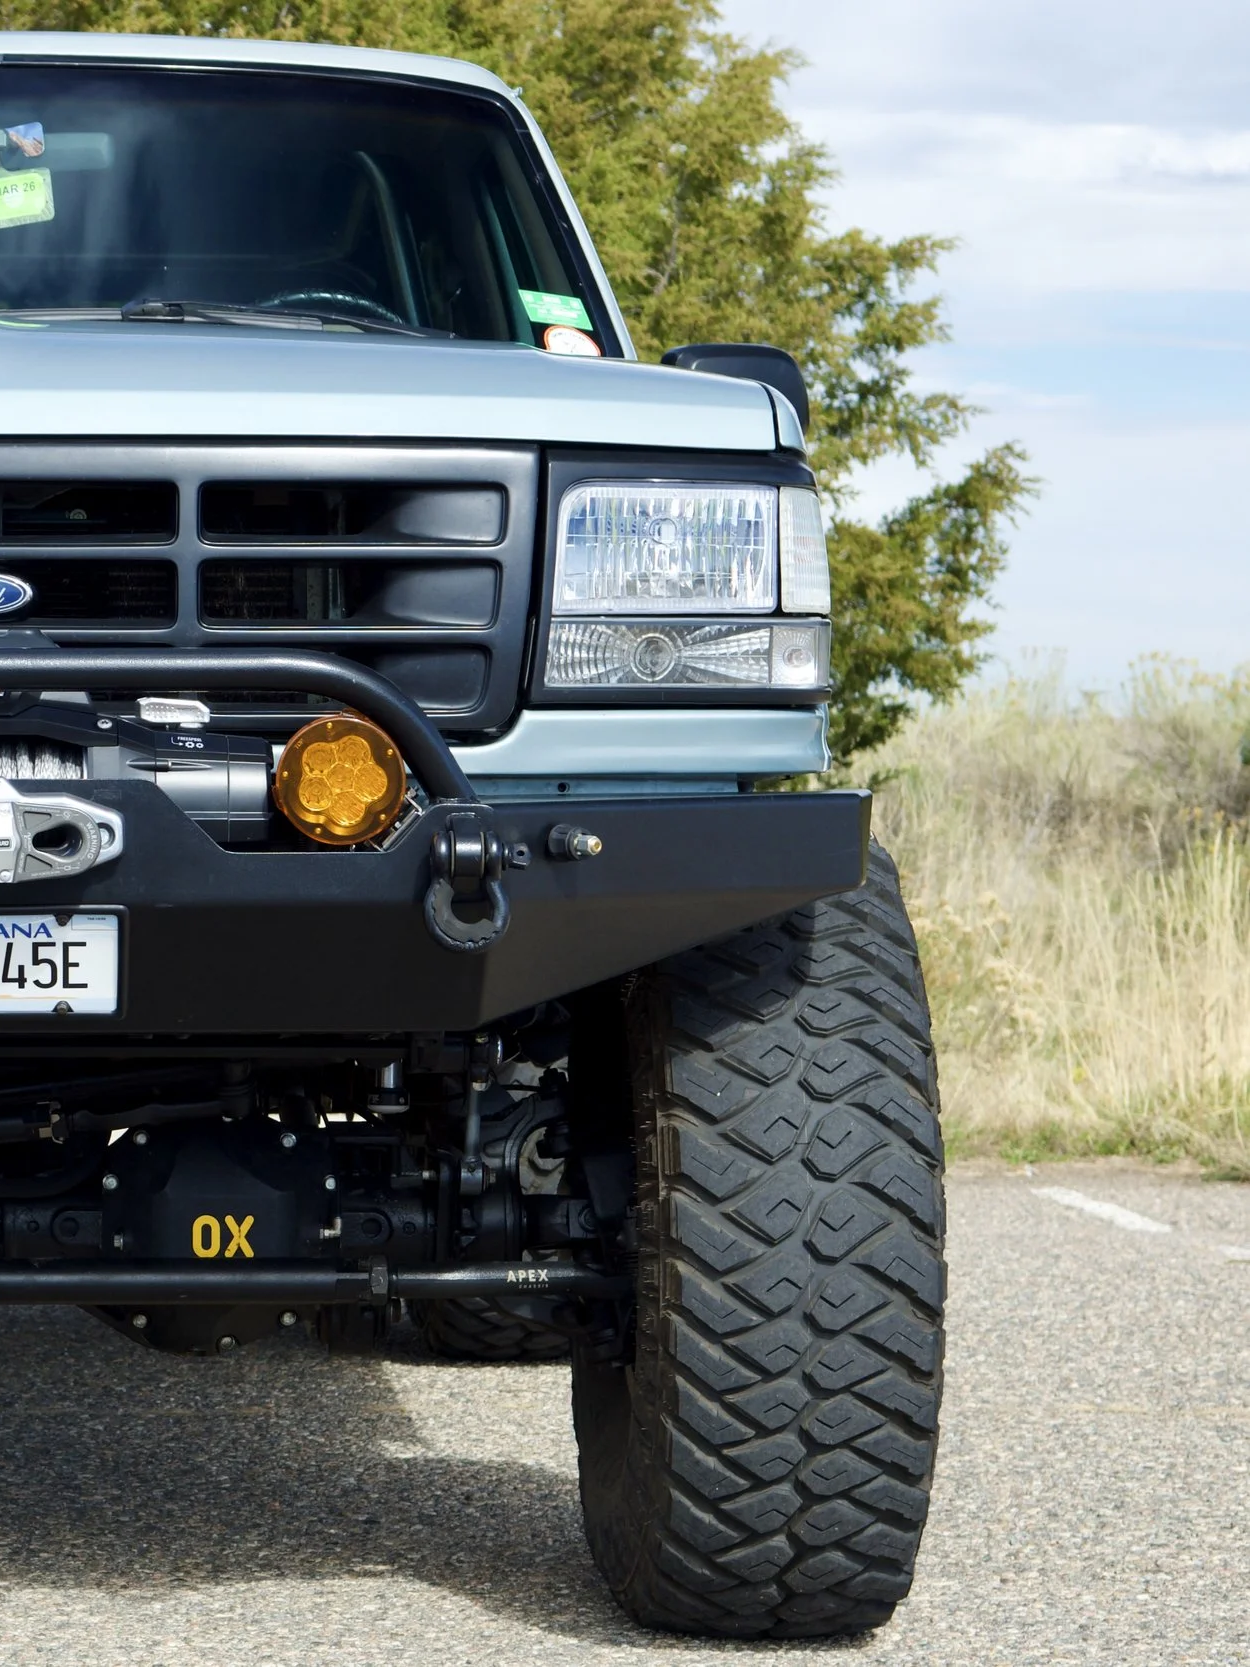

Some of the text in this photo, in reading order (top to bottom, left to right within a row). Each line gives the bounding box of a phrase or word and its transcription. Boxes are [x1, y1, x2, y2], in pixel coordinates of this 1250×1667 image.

[23, 181, 36, 192] 26
[86, 822, 98, 859] WARNING
[192, 1214, 255, 1258] OX
[507, 1269, 549, 1282] APEX
